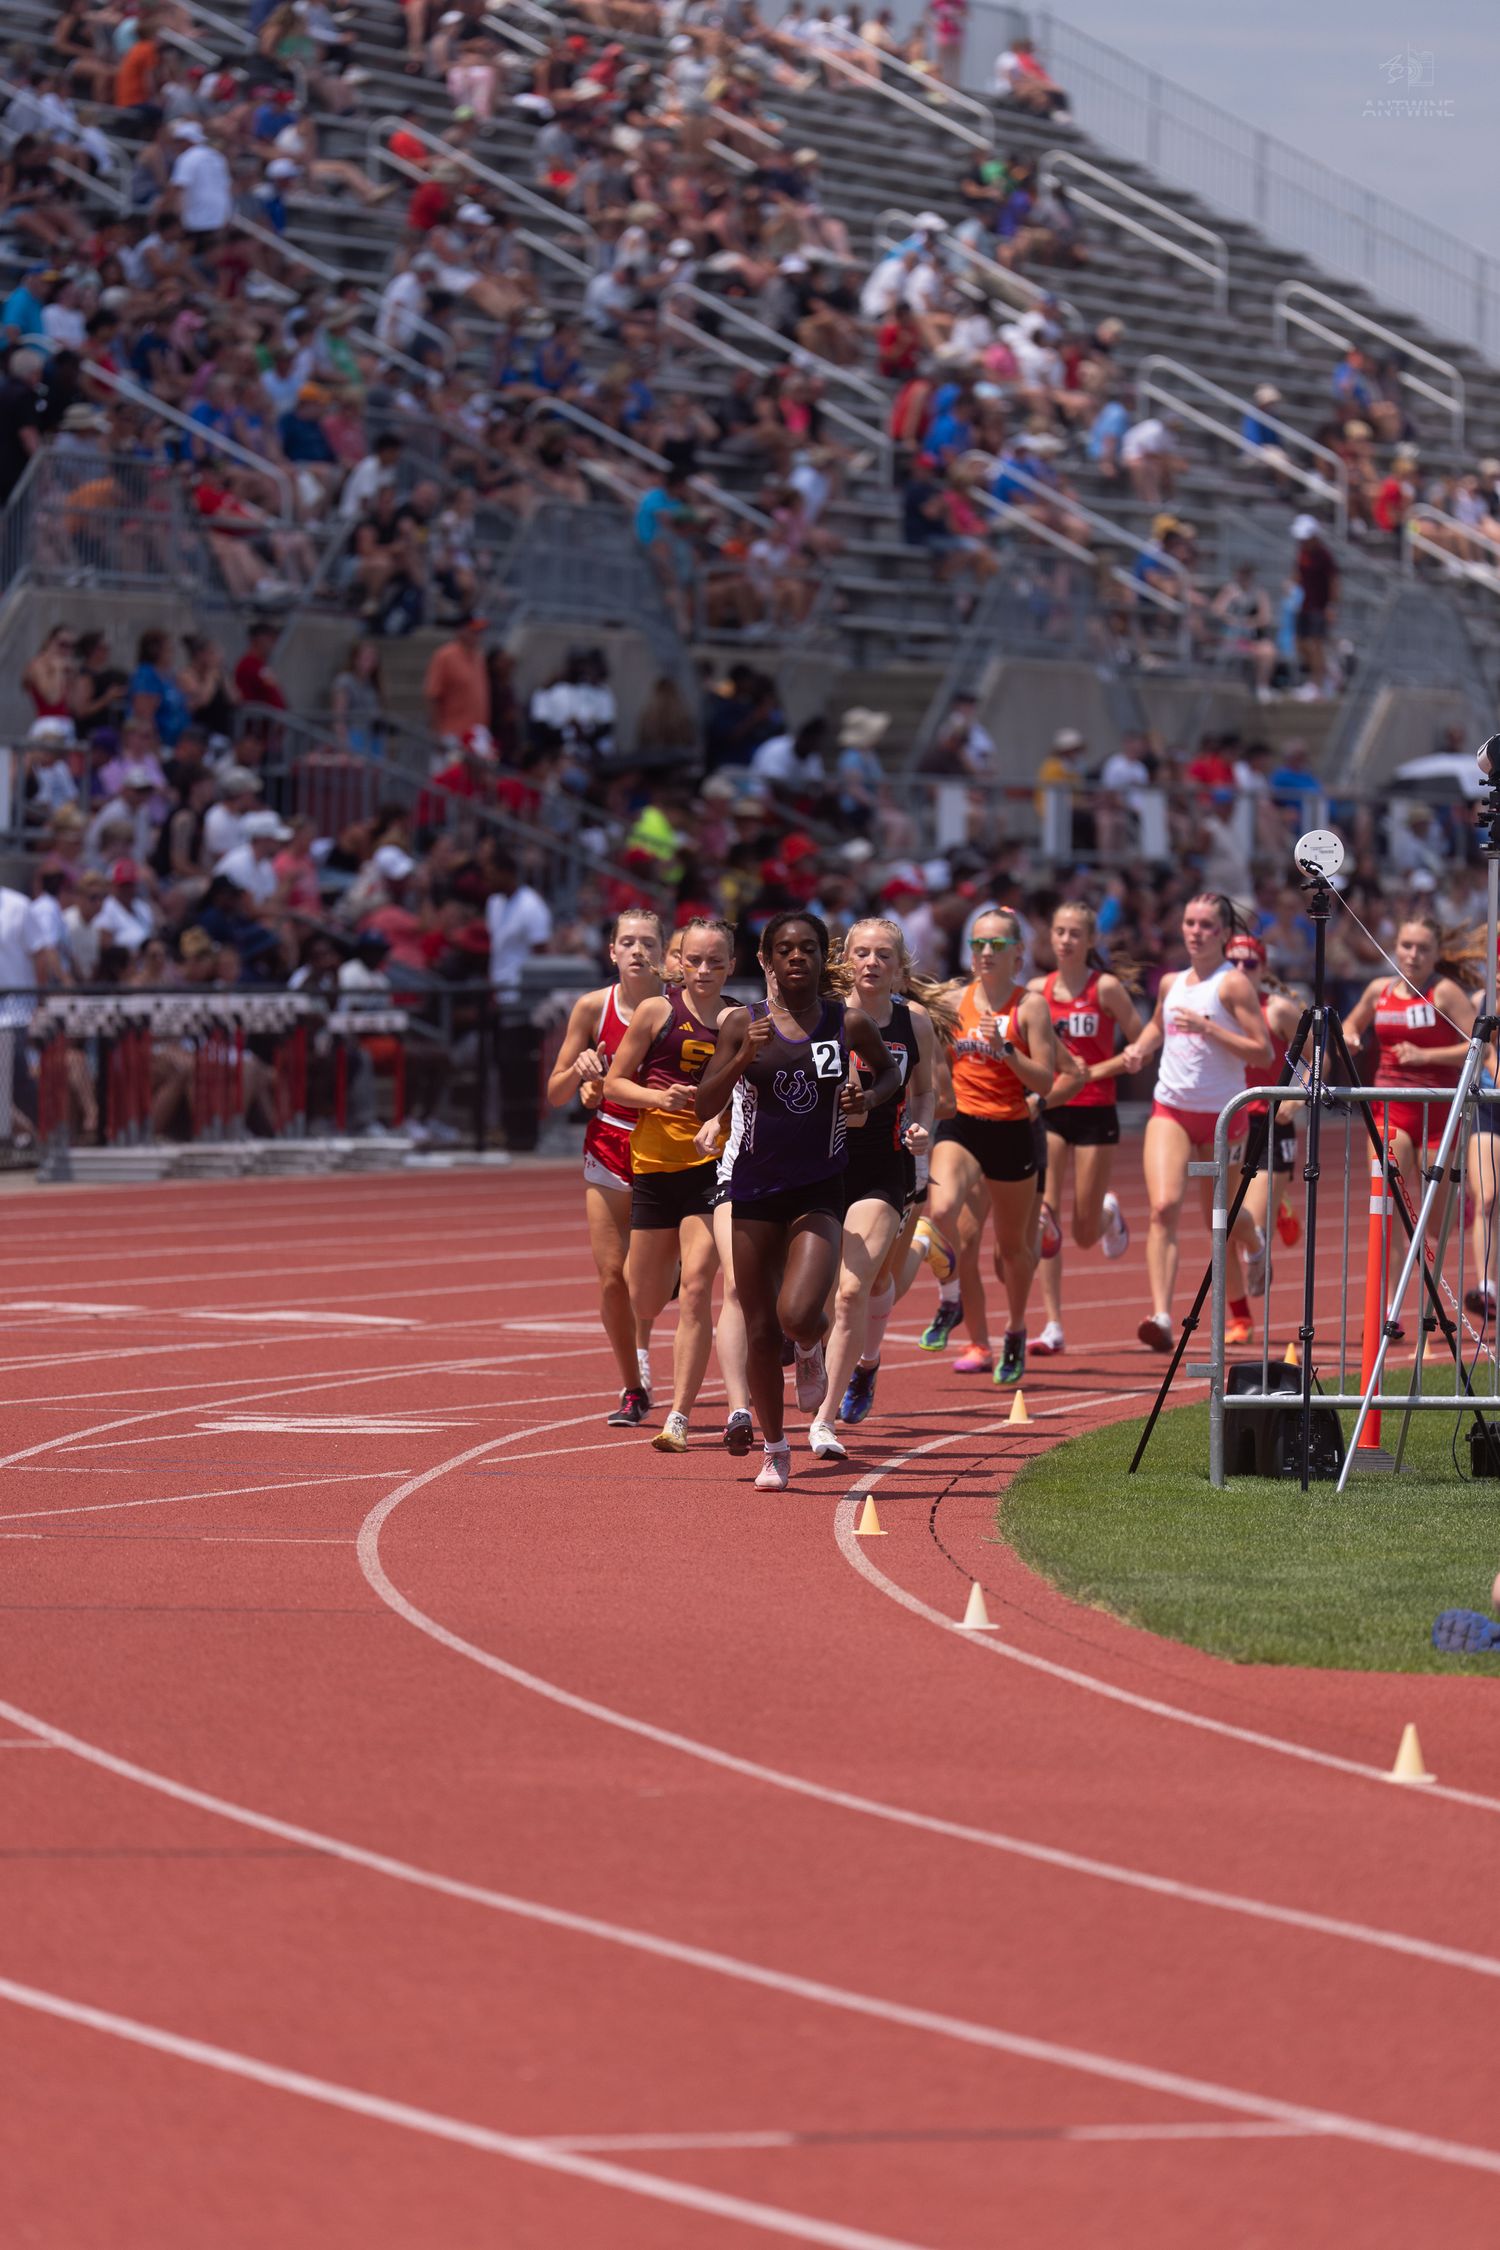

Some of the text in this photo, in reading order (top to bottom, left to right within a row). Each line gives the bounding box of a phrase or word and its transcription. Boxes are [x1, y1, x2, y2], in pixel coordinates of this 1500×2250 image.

[1073, 1014, 1095, 1036] 16
[1411, 1006, 1428, 1029] 11
[816, 1043, 839, 1076] 2
